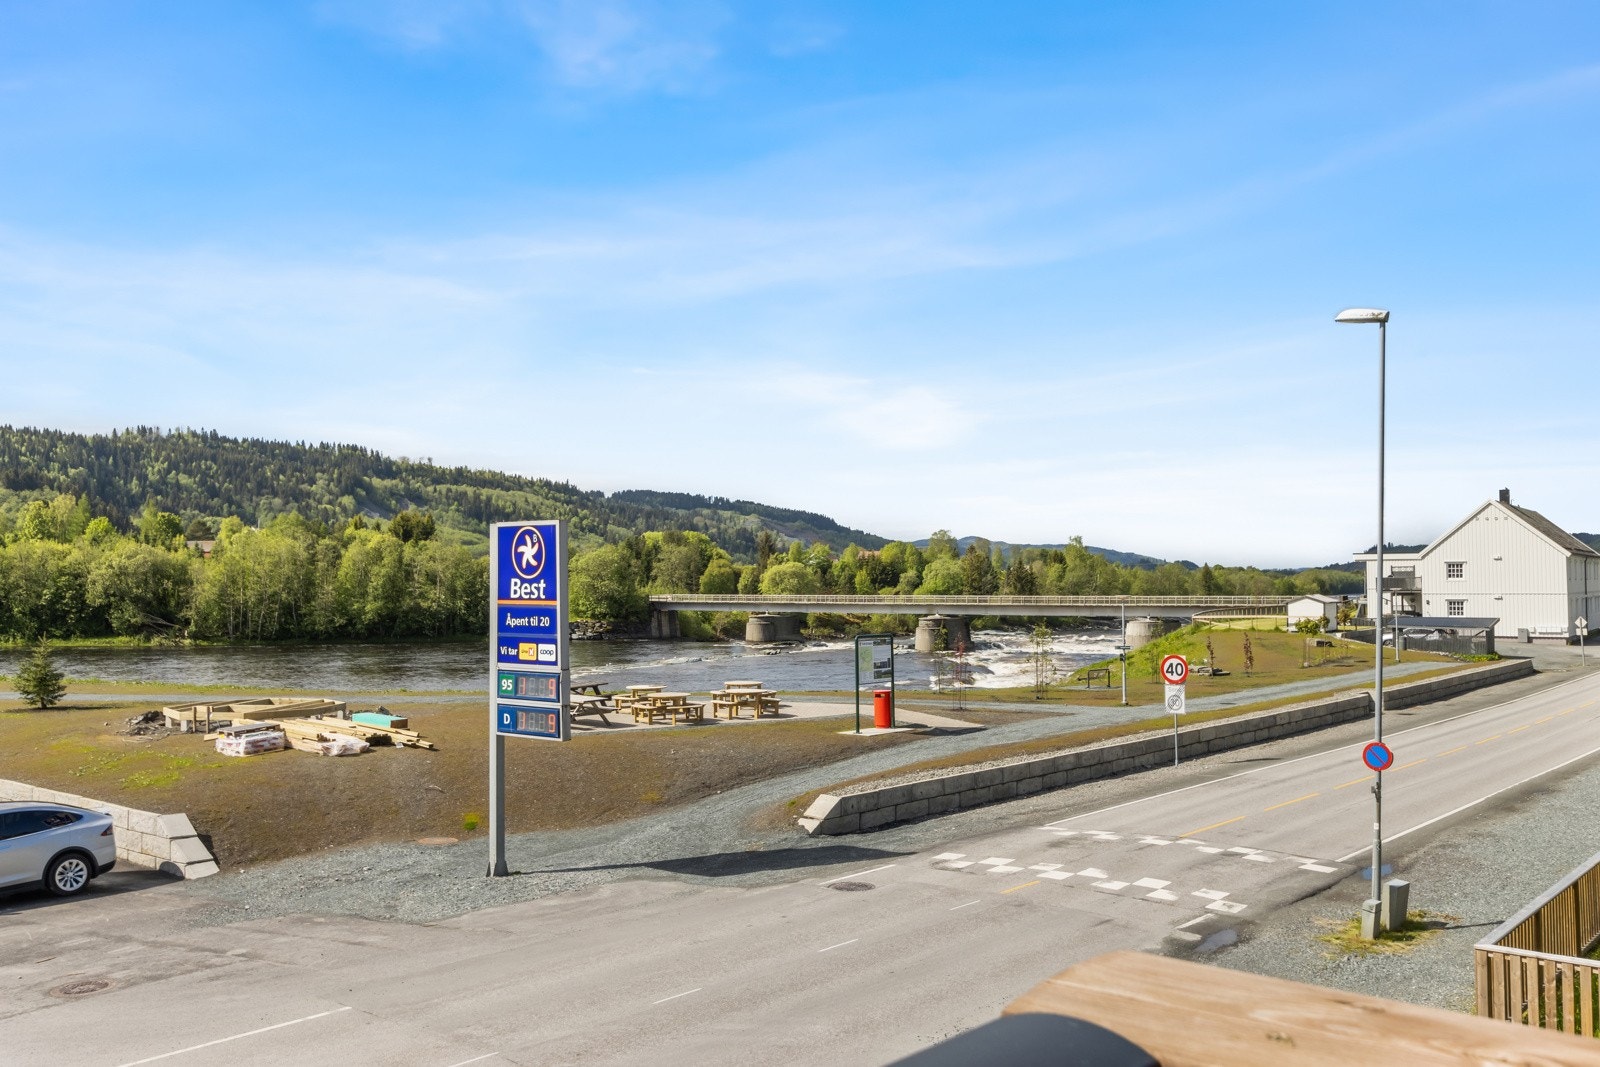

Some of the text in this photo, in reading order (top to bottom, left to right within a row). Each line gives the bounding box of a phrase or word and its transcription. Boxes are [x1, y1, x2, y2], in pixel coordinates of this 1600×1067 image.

[510, 578, 546, 599] Best
[506, 612, 550, 628] Åpent til 20
[500, 646, 507, 655] Vi
[508, 647, 518, 655] tar
[1166, 663, 1183, 676] 40
[502, 679, 512, 690] 95
[503, 713, 510, 724] D
